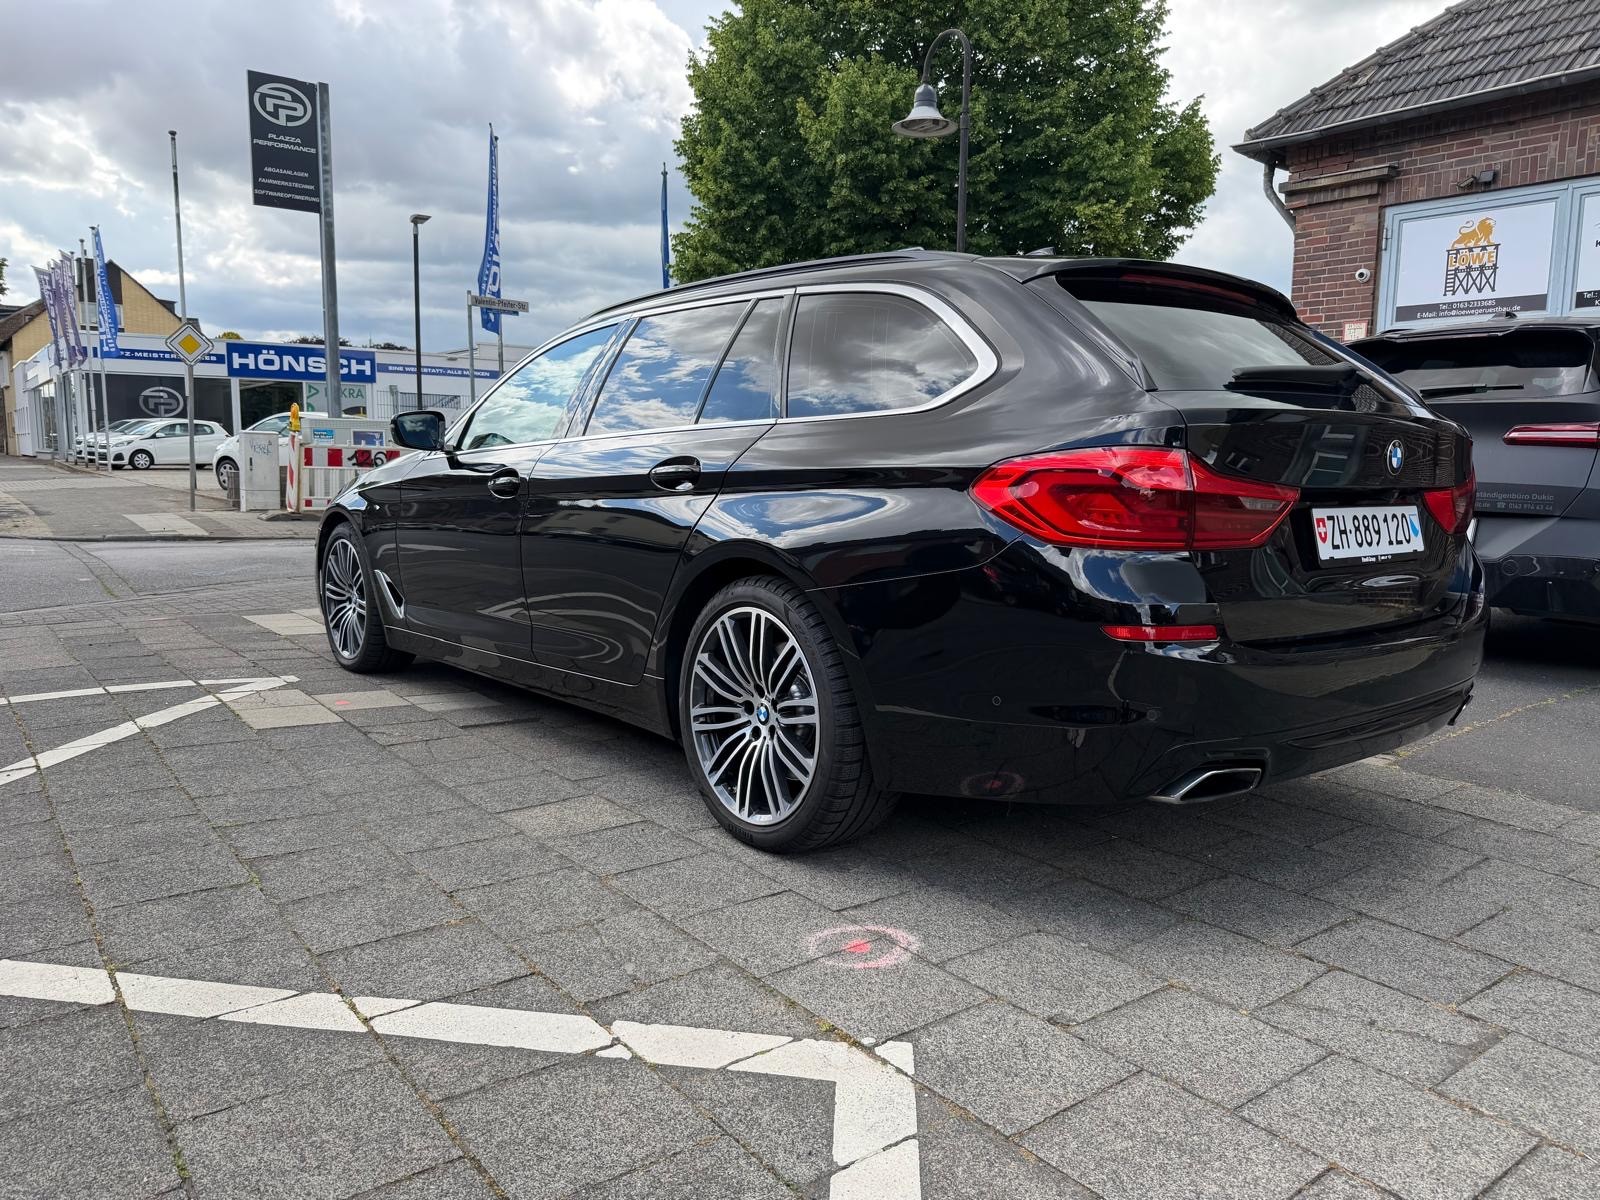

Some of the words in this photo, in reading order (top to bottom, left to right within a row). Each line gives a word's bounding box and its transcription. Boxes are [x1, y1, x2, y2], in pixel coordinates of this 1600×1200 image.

[268, 133, 302, 143] PLAZZA
[253, 138, 317, 154] PERFORMANCE
[264, 166, 309, 177] ABGASANLAGEN
[258, 177, 316, 190] FAHRWERKSTECHNIK
[1448, 250, 1496, 267] LÖWE
[1452, 299, 1496, 309] 0163-2333685
[1417, 311, 1438, 319] E-Mail:
[1439, 305, 1521, 317] info@loewegeruestbau.de
[232, 349, 372, 376] HÖNSCH
[1383, 512, 1411, 546] 120
